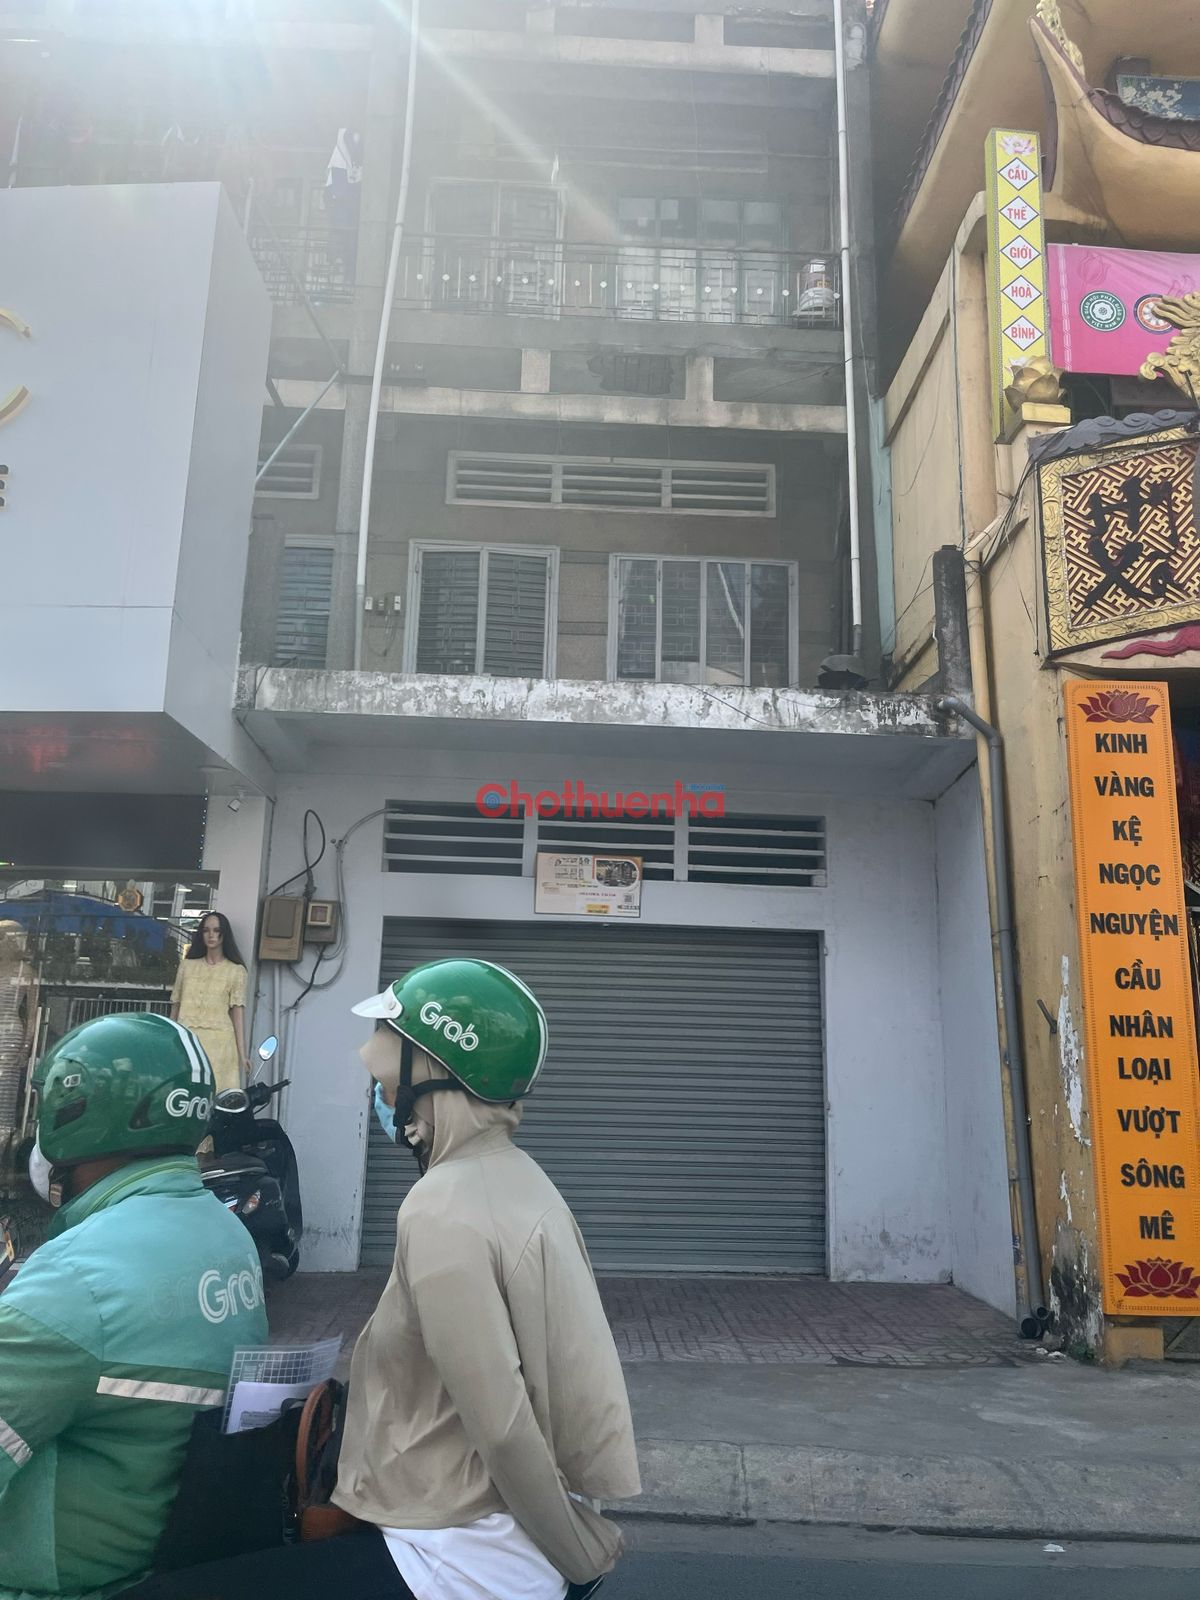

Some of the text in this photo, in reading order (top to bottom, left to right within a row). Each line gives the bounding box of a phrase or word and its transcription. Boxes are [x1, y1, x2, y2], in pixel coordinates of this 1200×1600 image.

[1007, 205, 1028, 220] THẾ
[1009, 244, 1032, 260] GIỚI
[1010, 283, 1033, 298] HOÀ
[1011, 324, 1036, 340] BÌNH
[1090, 732, 1186, 1240] KINH VÀNG KỆ NGỌC NGUYỆN CẦU NHÂN LOẠI VƯỢT SÔNG MÊ
[420, 1001, 479, 1052] Grab
